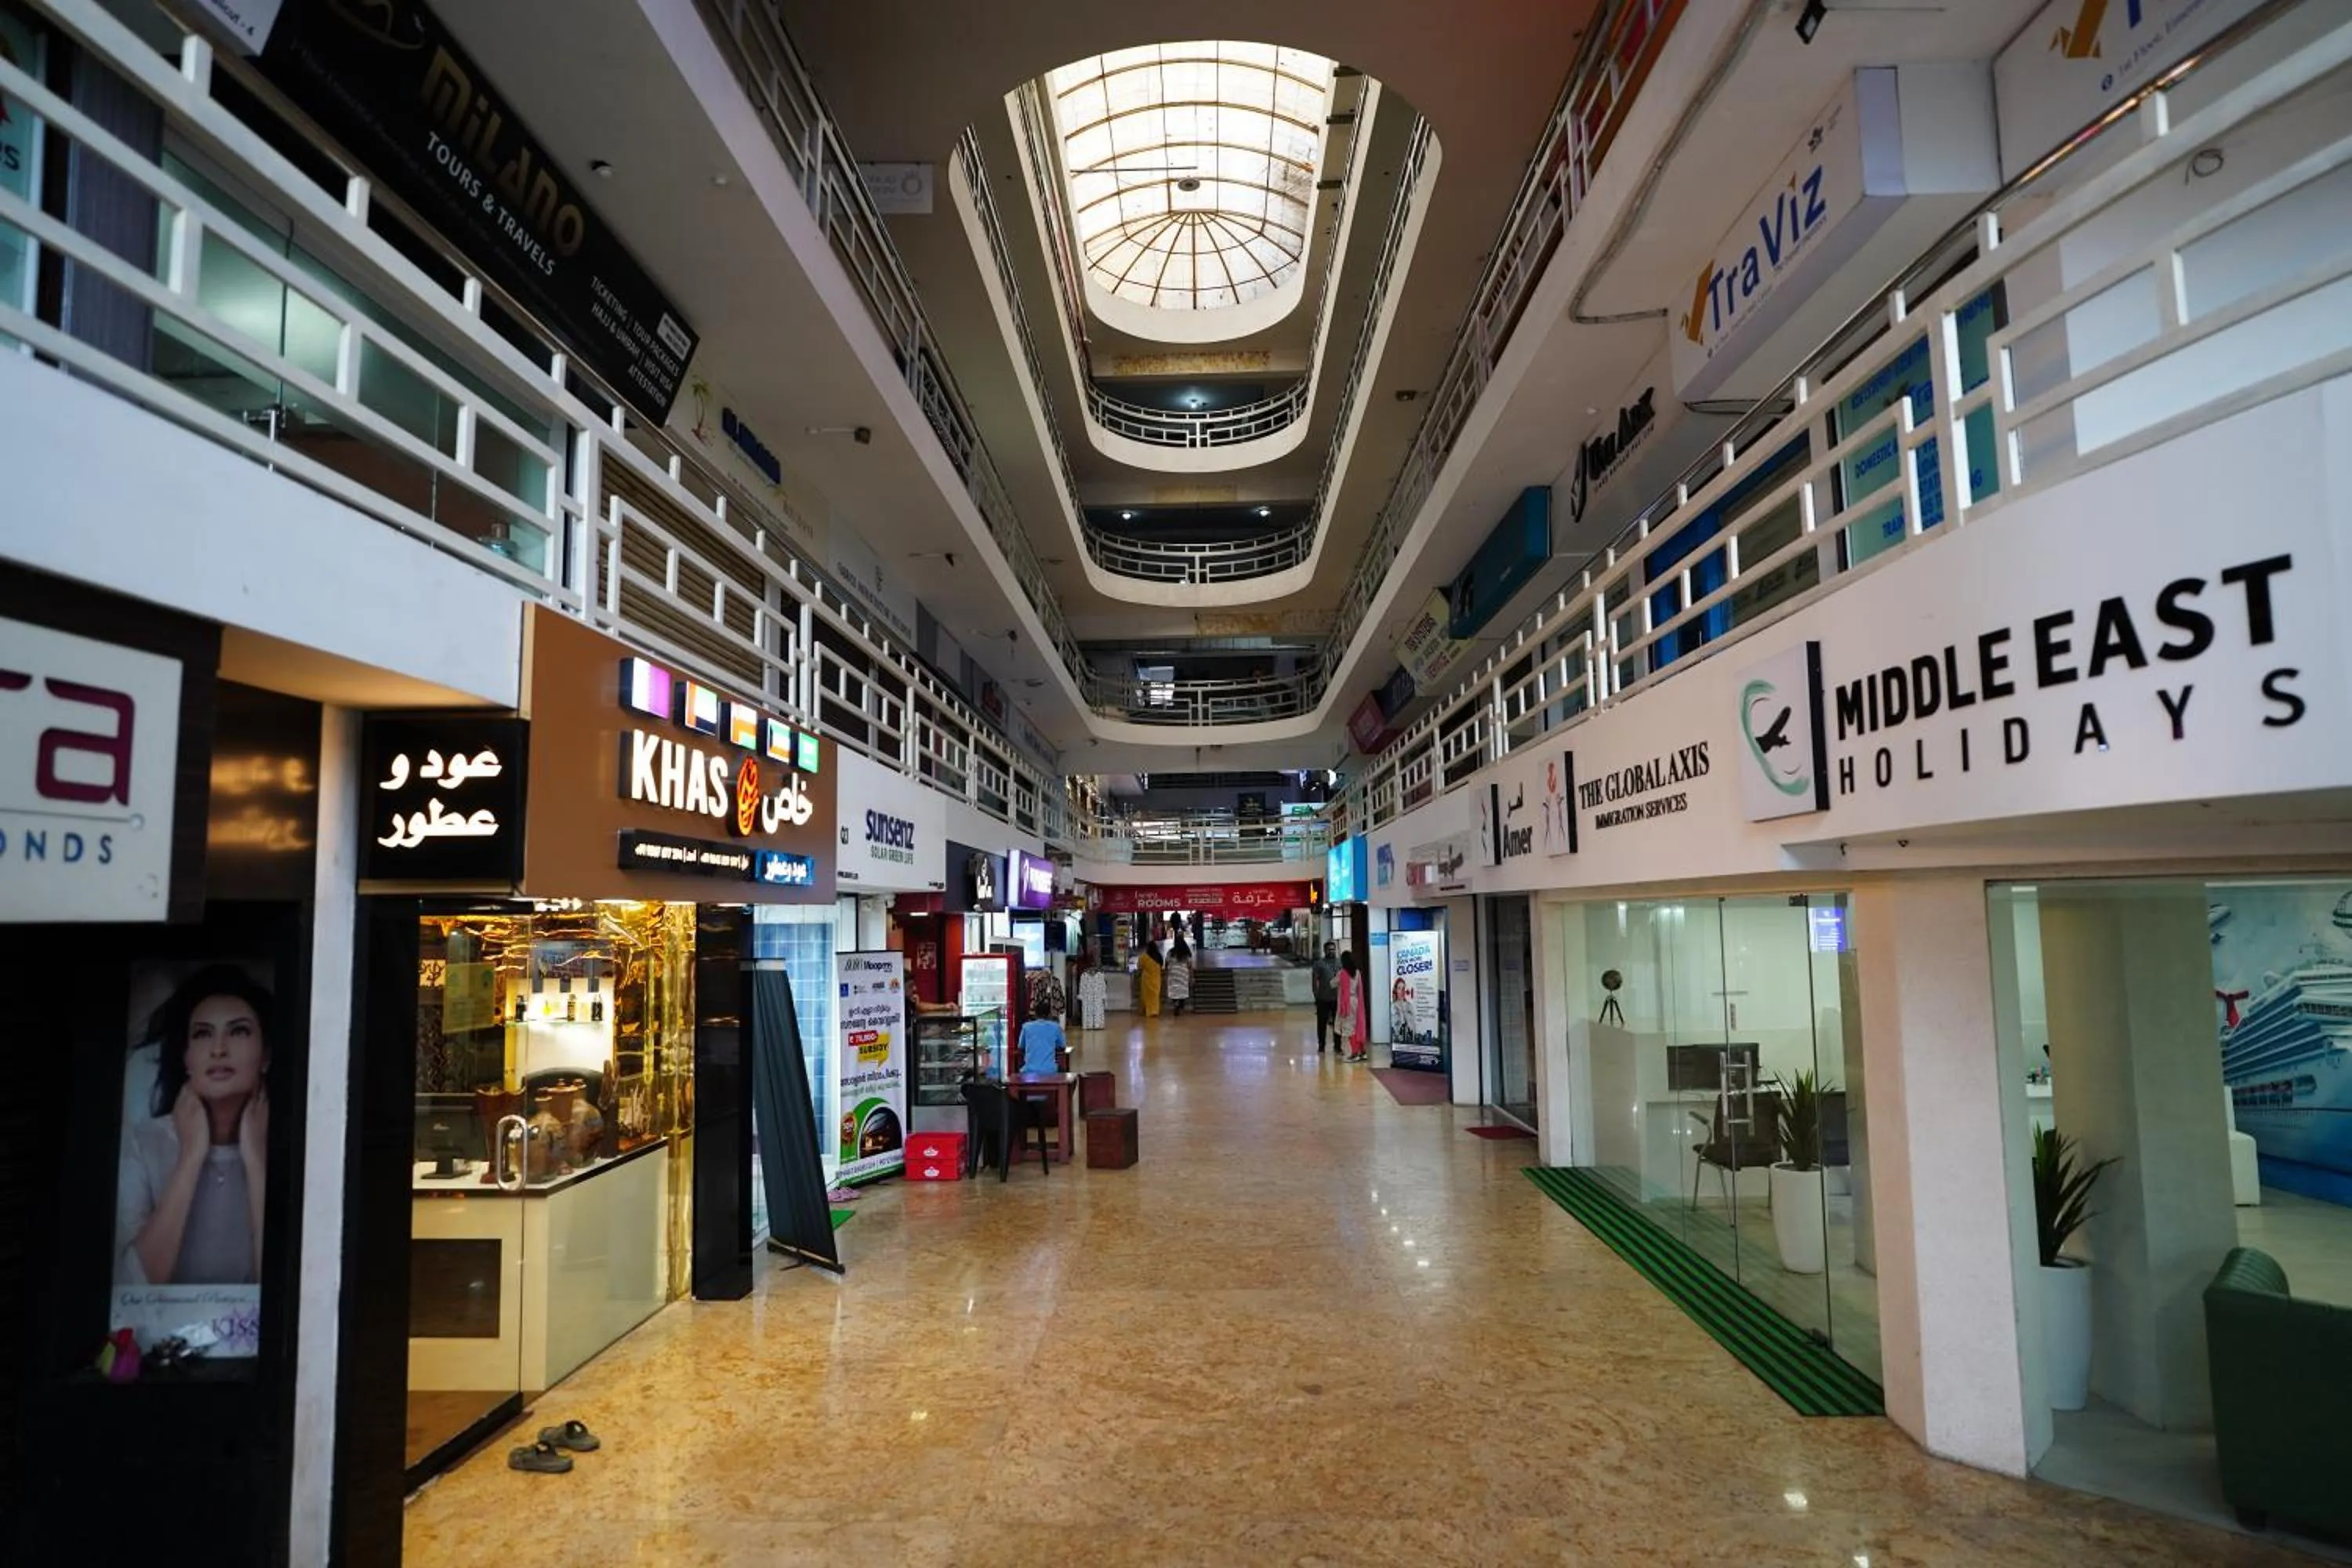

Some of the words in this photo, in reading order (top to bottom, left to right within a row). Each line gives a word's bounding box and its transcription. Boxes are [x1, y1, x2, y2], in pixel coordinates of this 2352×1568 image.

[426, 131, 482, 197] TOURS
[482, 193, 495, 214] &
[494, 206, 555, 276] TRAVELS
[590, 275, 628, 321] TICKETING
[628, 364, 667, 408] ATTESTATION
[1836, 627, 2015, 741] MIDDLE
[2034, 554, 2292, 688] EAST
[1839, 667, 2307, 795] HOLIDAYS
[420, 749, 502, 789] عود
[631, 729, 729, 818] KHAS
[762, 772, 813, 834] خاص
[1579, 778, 1602, 809] THE
[1595, 805, 1644, 829] IMMIGRATION
[1646, 793, 1688, 820] SERVICES
[377, 797, 499, 848] عطور
[1503, 825, 1533, 858] Amer
[1138, 898, 1181, 909] ROOMS
[1396, 960, 1433, 976] CLOSER!
